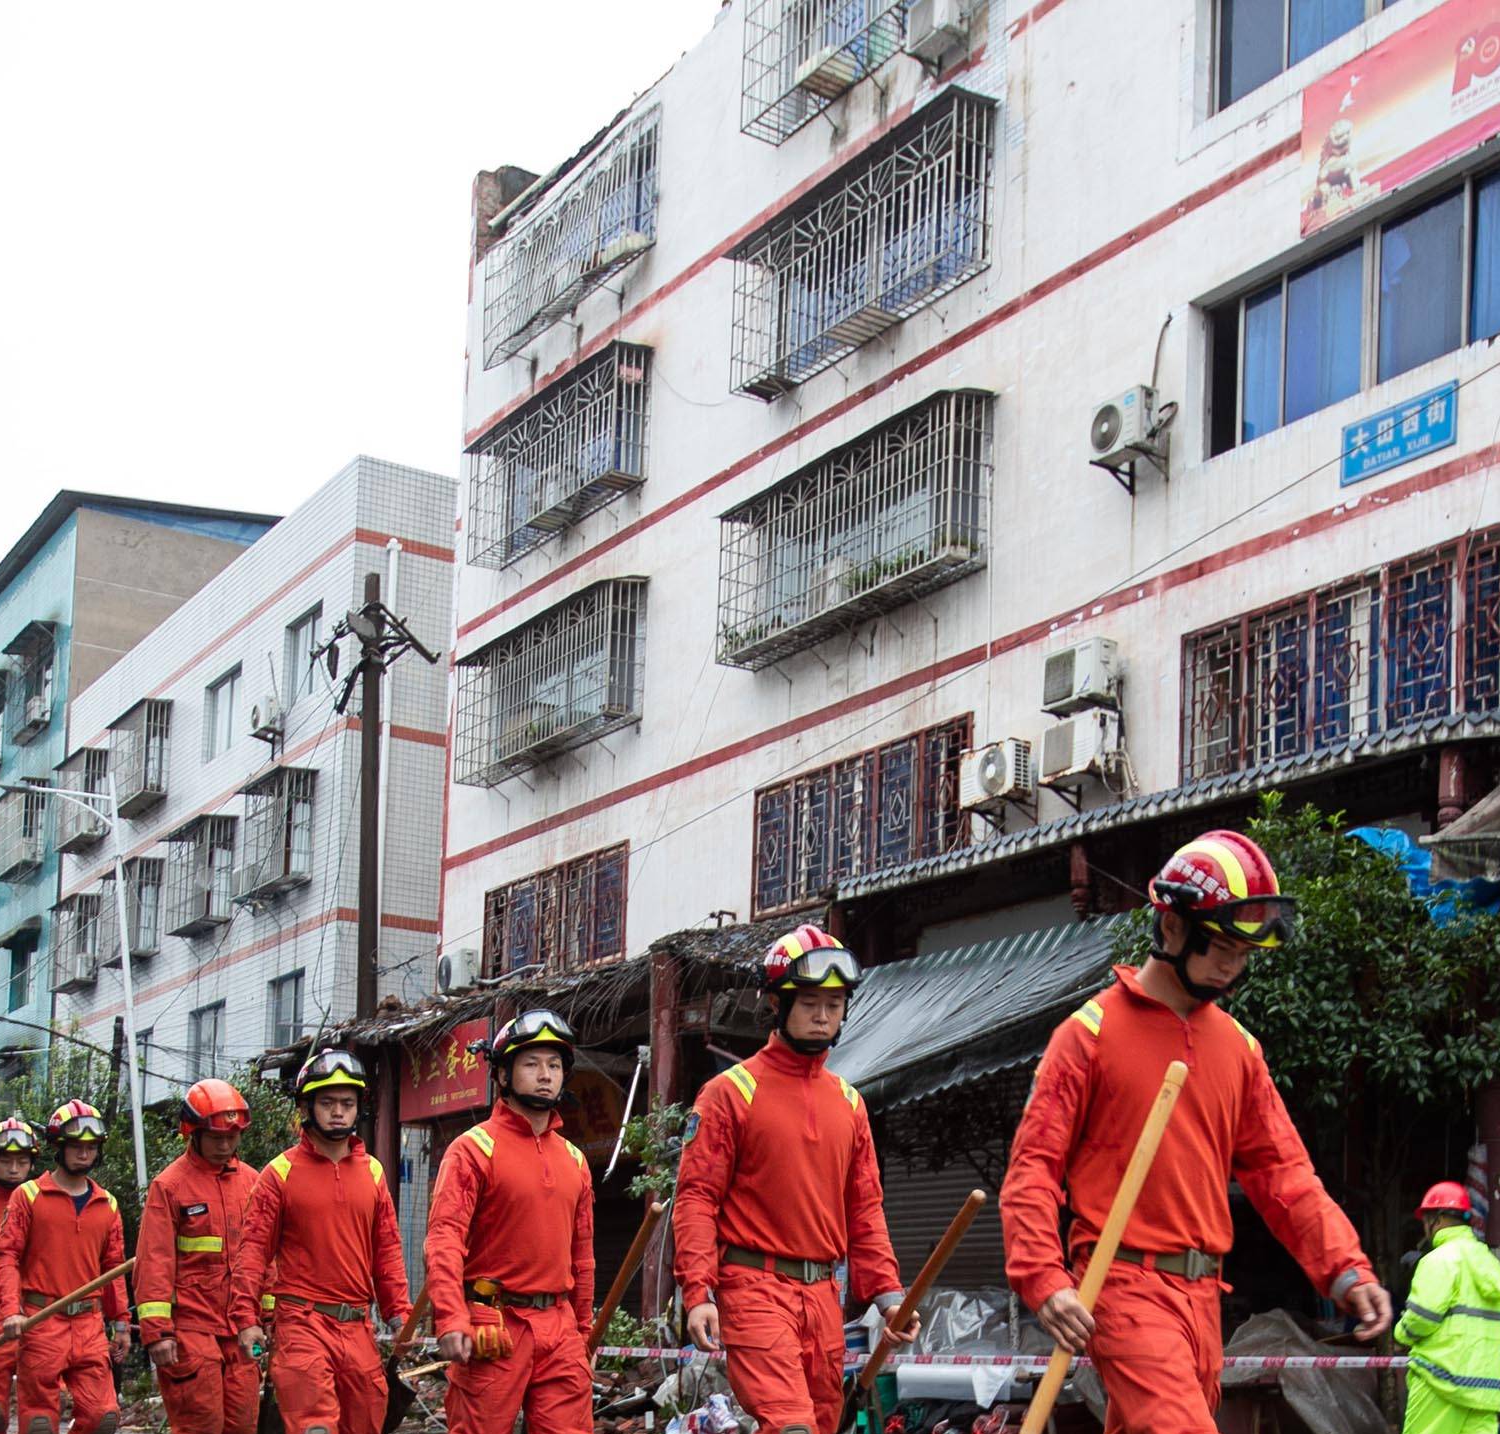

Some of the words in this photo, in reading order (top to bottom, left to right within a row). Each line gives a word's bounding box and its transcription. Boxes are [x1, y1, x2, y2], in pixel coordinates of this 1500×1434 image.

[1350, 395, 1447, 459] 大田西街
[1363, 447, 1400, 469] DATIAN
[1406, 433, 1431, 451] XIJIE
